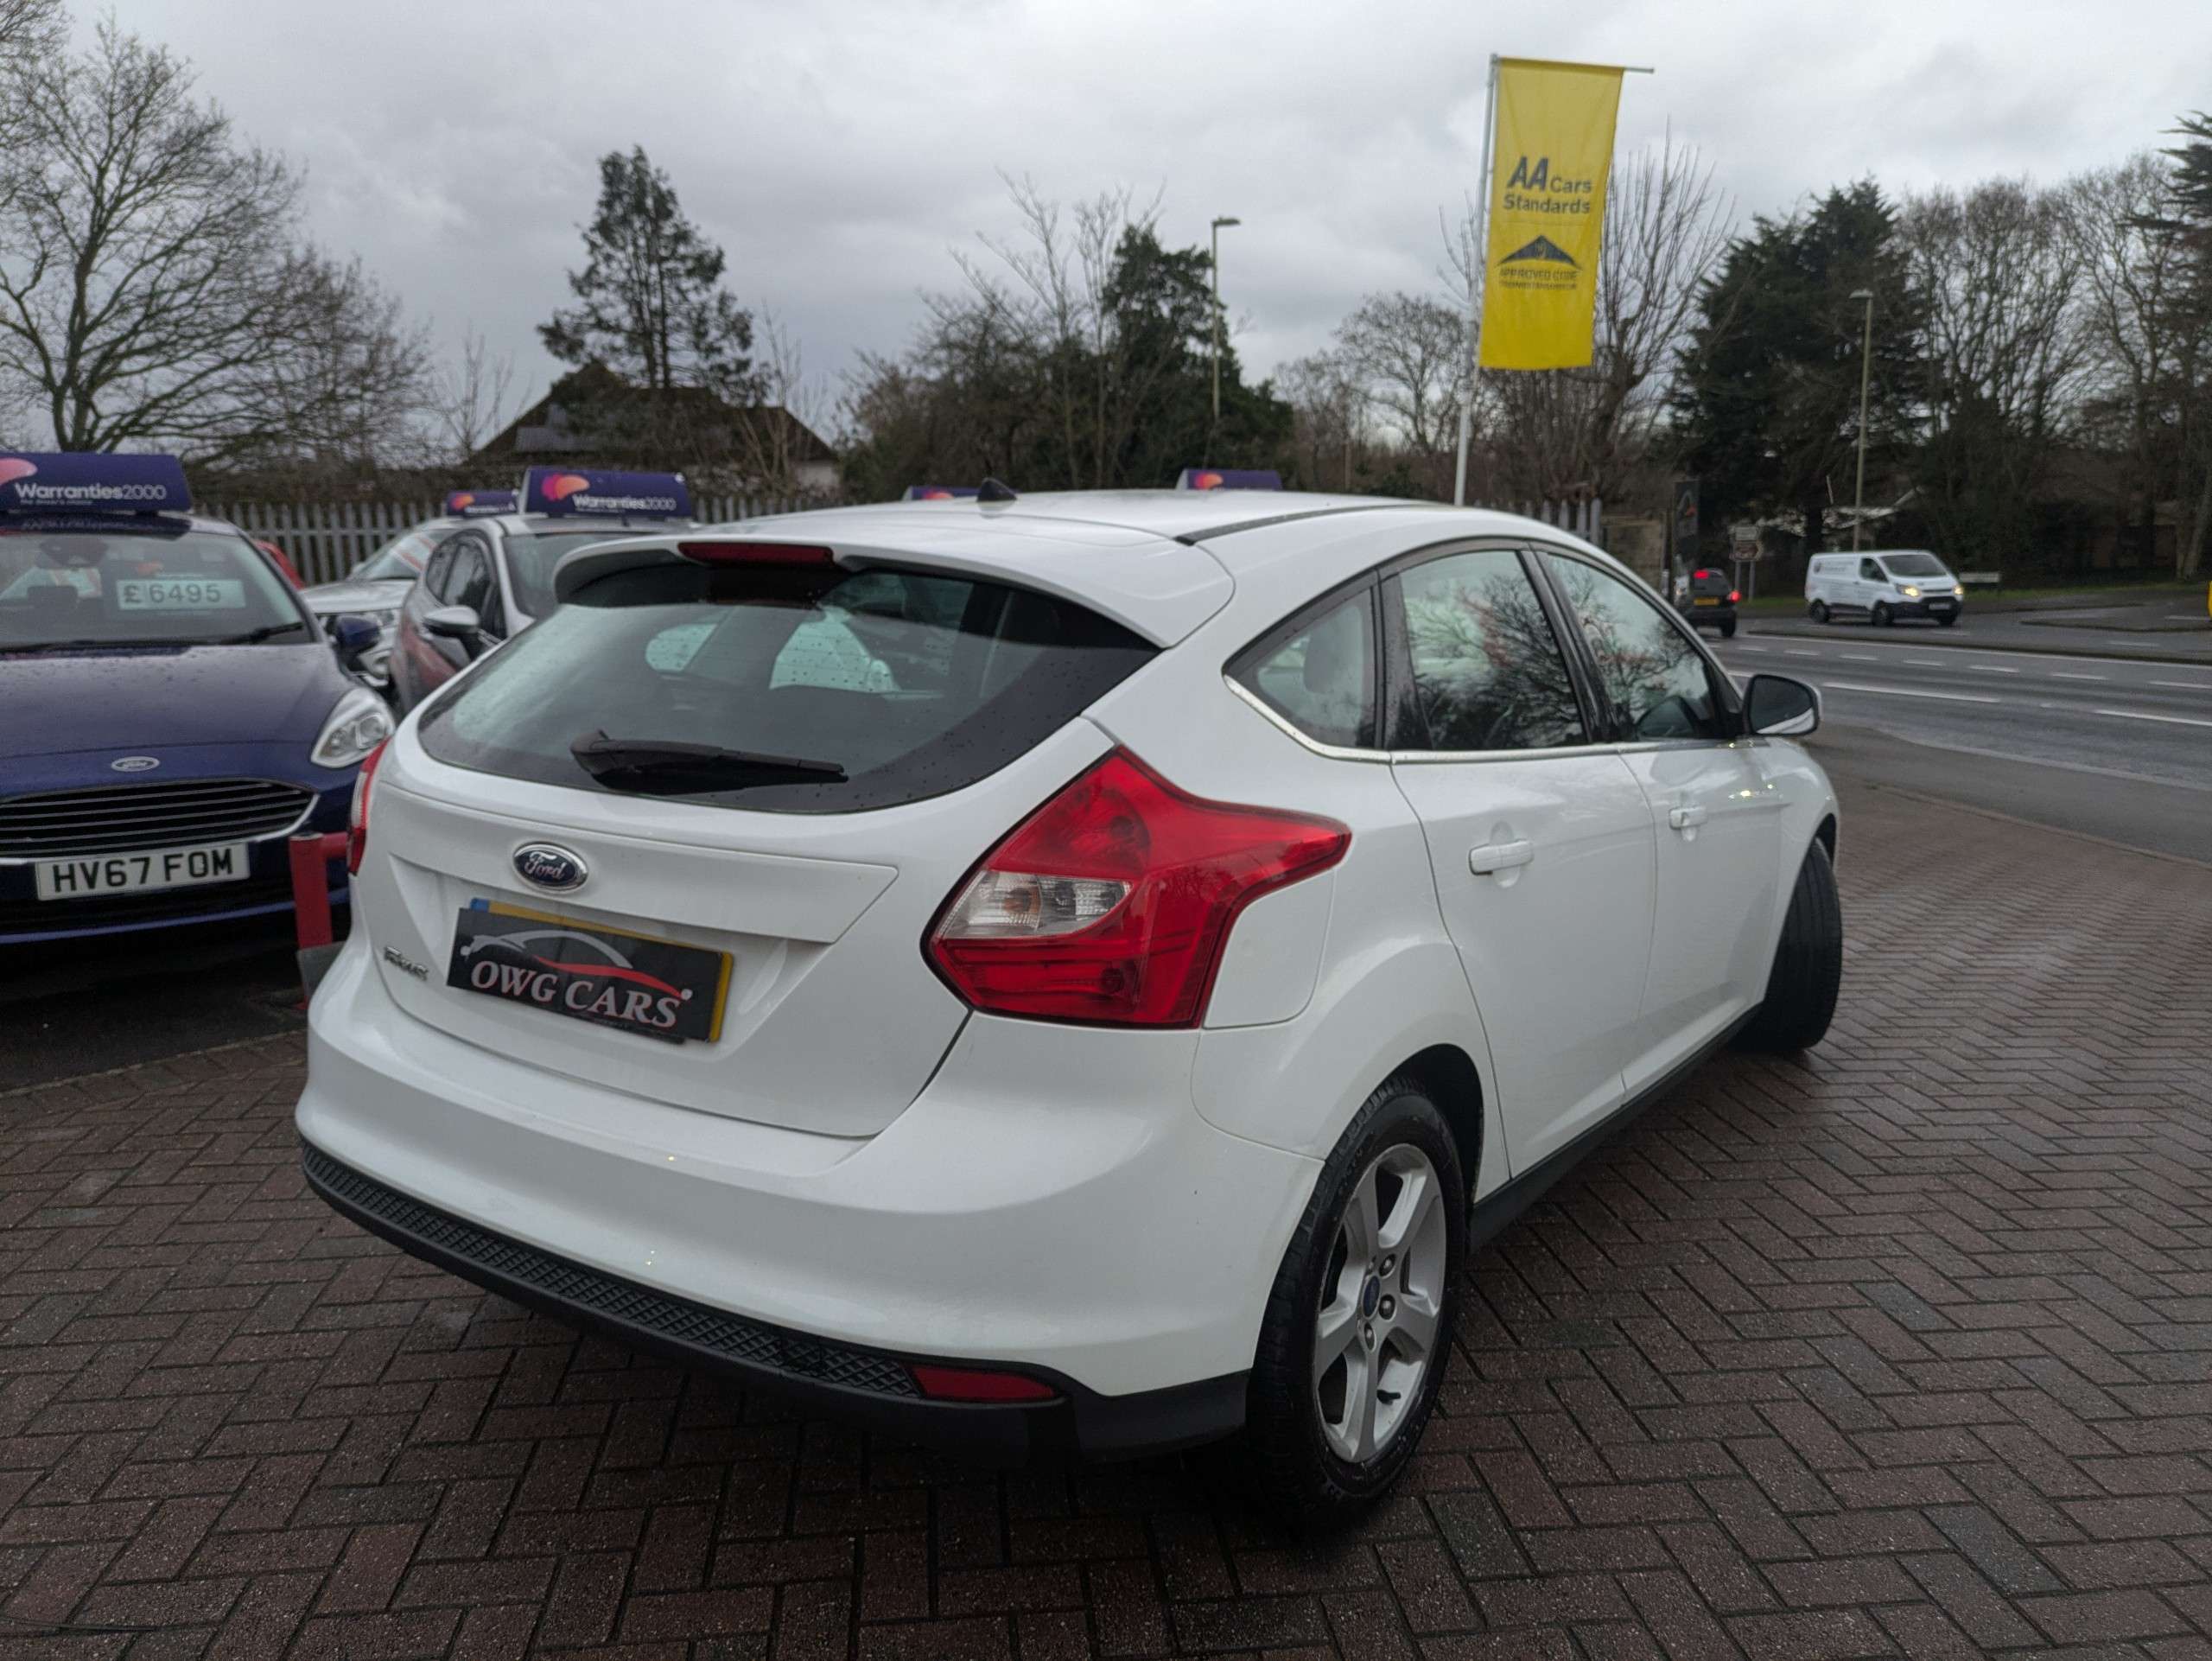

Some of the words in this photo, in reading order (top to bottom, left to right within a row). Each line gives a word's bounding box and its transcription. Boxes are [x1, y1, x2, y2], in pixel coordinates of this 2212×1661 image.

[1507, 156, 1548, 191] AA
[1550, 175, 1592, 194] Cars
[1503, 194, 1591, 214] Standards
[15, 482, 167, 500] Warranties2000
[572, 493, 677, 511] Warranties2000
[123, 583, 220, 603] £6495
[53, 856, 150, 893] HV67
[524, 850, 568, 880] Ford
[471, 960, 557, 1002] OWG
[564, 980, 681, 1028] CARS
